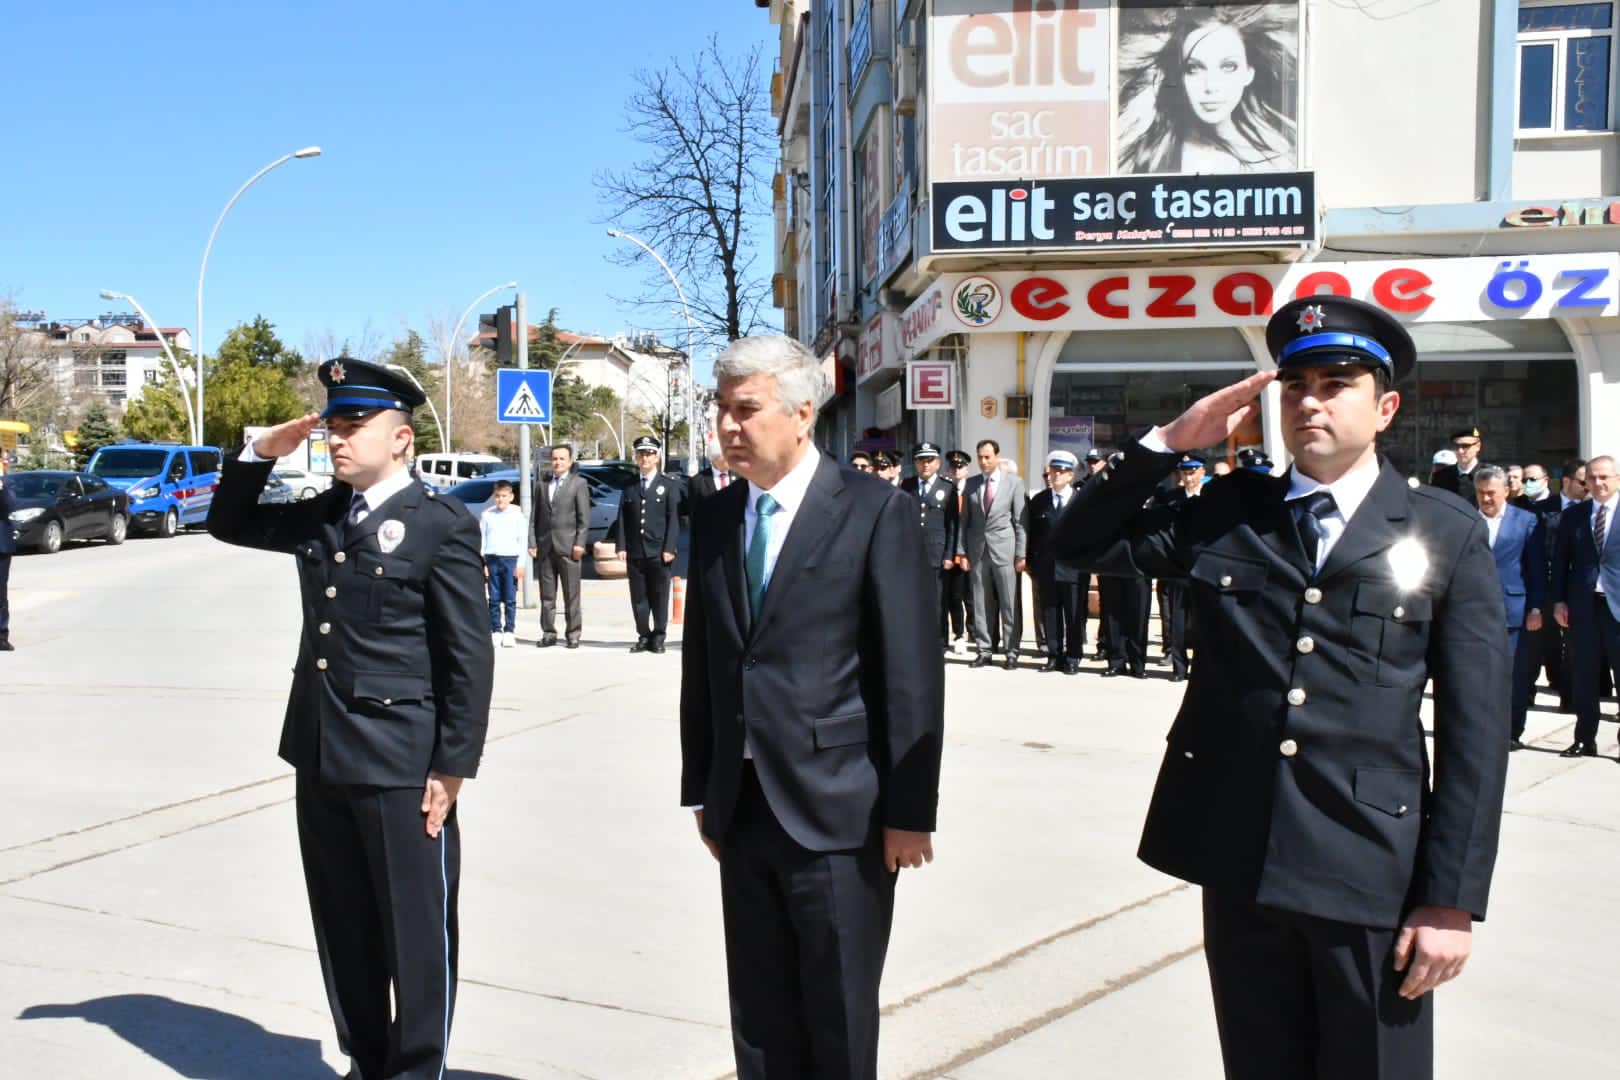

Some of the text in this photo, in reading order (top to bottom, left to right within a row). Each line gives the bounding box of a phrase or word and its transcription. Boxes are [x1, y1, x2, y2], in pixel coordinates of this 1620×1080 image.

[949, 0, 1097, 88] elit
[952, 140, 1094, 177] tasarım
[945, 187, 1055, 242] elit
[1073, 191, 1137, 225] saç
[1151, 183, 1303, 220] tasarım
[1010, 261, 1610, 321] eczane öz
[919, 370, 944, 399] E
